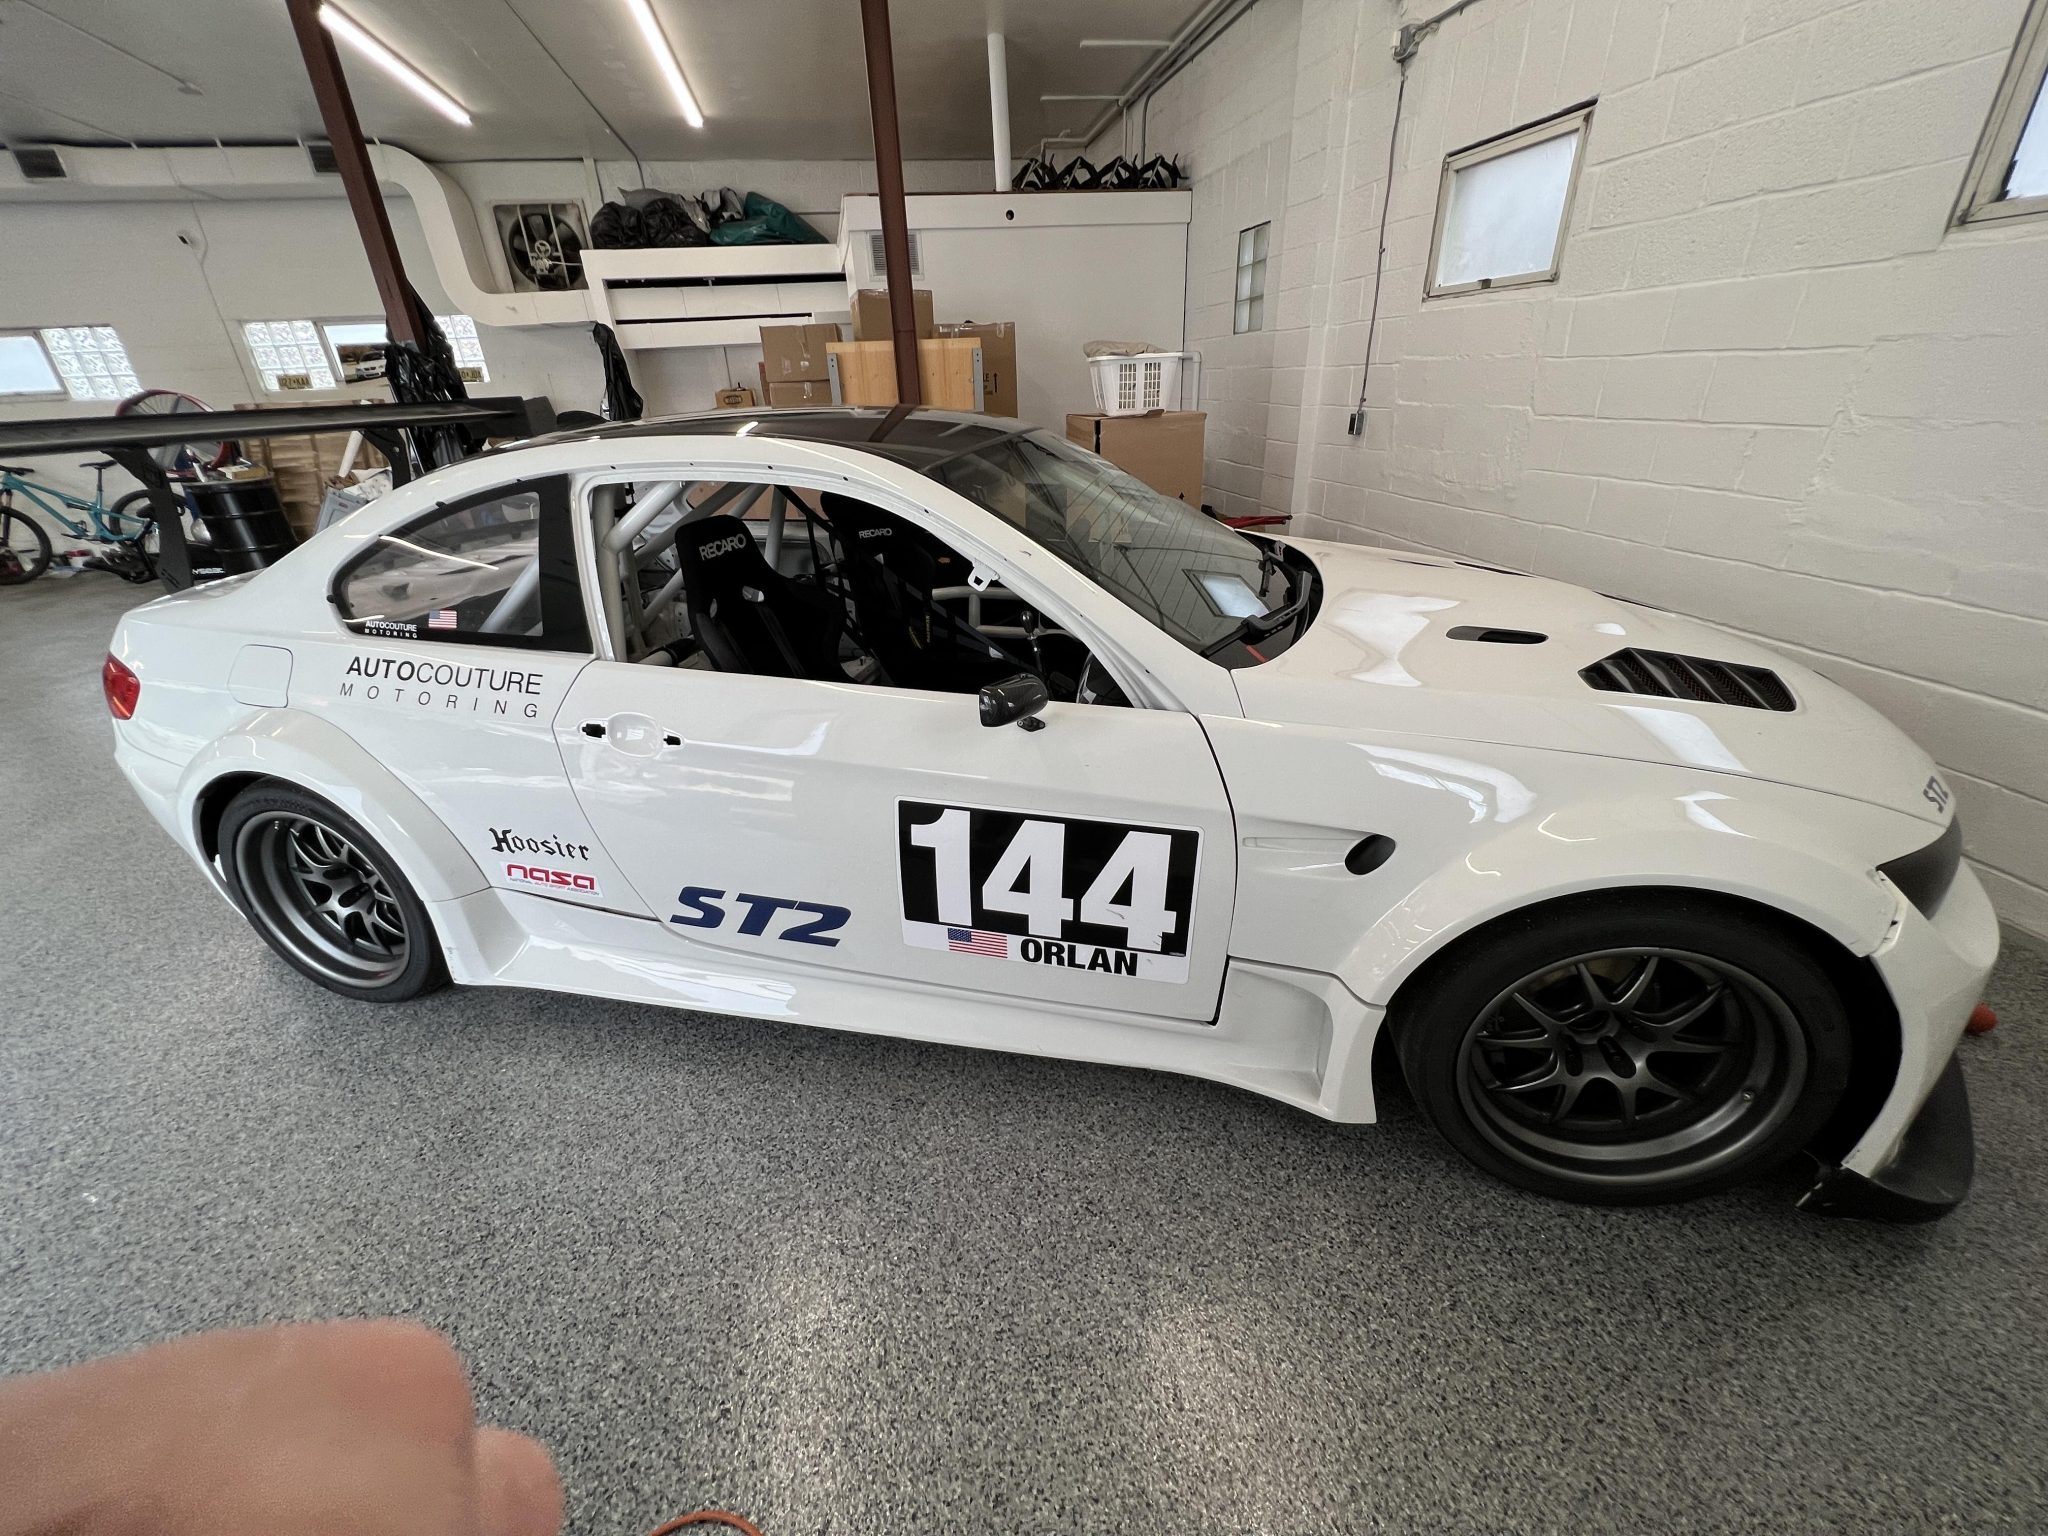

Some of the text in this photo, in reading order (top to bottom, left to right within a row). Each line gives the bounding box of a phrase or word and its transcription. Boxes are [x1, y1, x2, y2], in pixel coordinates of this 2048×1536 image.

[699, 533, 747, 560] RECARO
[859, 527, 892, 539] RECARO
[364, 628, 418, 639] MOTORING
[366, 620, 417, 632] AUTOCOUTURE
[346, 656, 543, 695] AUTOCOUTURE
[340, 682, 538, 718] MOTORING
[488, 827, 589, 861] Hoosier
[910, 808, 1176, 952] 144
[669, 885, 852, 948] ST2
[1020, 938, 1139, 977] ORLAN
